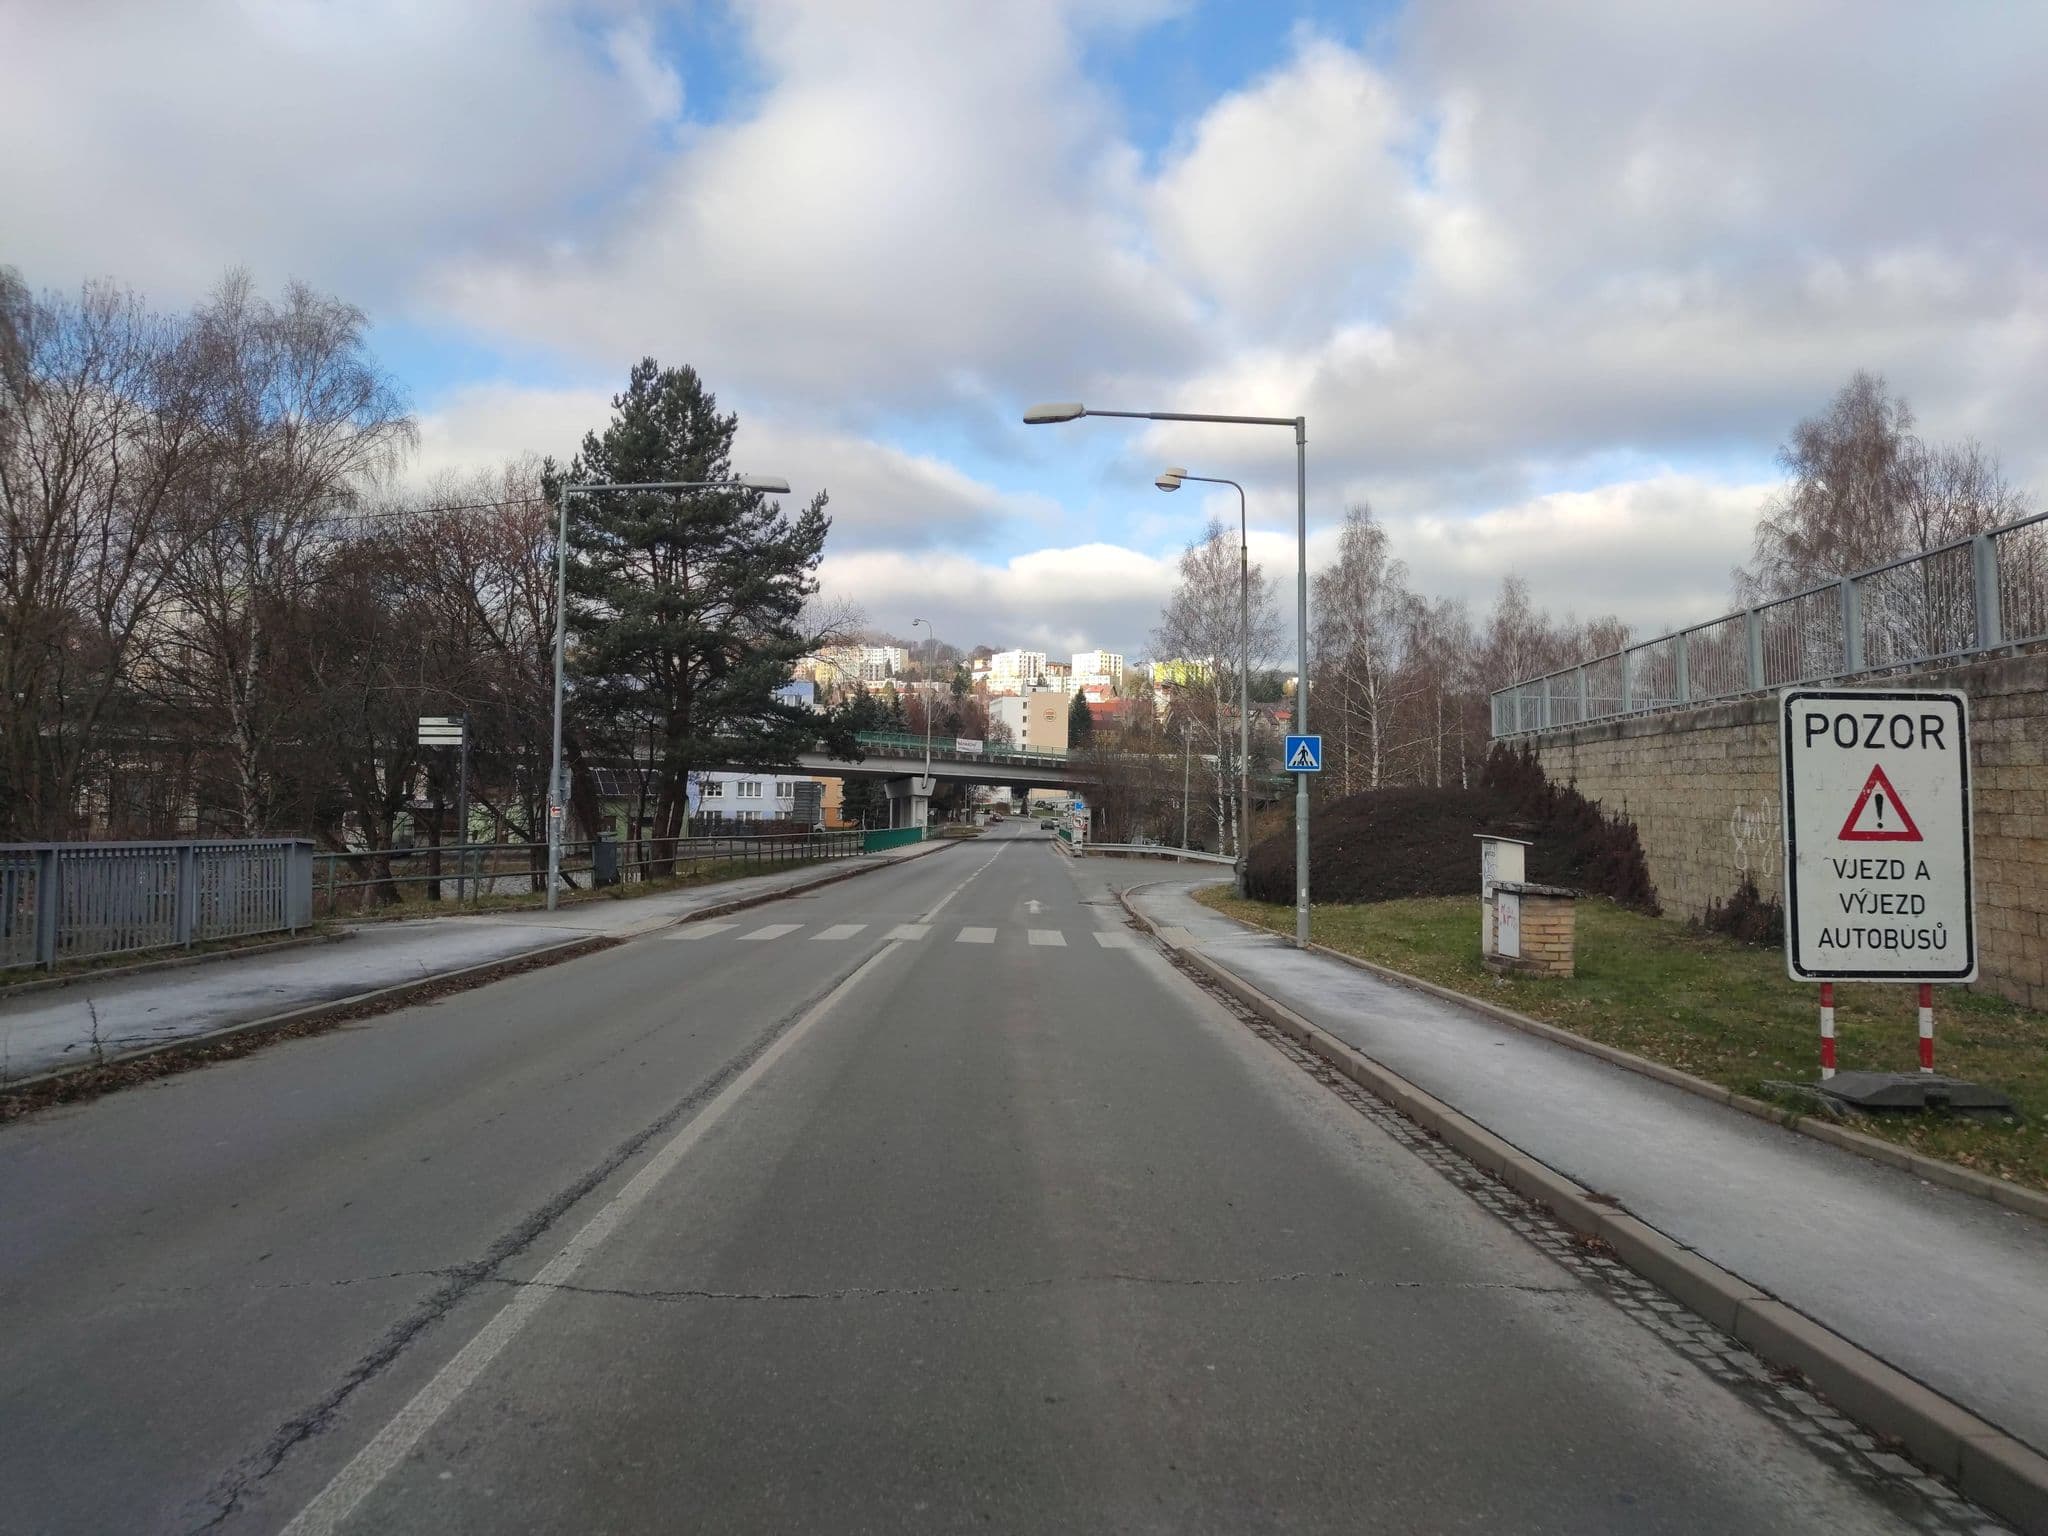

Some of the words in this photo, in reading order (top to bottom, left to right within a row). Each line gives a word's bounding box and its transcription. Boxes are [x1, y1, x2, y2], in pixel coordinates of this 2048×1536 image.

[1805, 712, 1946, 750] POZOR
[1832, 858, 1905, 880] VJEZD
[1914, 859, 1931, 880] A
[1839, 888, 1926, 915] VÝJEZD
[1817, 922, 1947, 950] AUTOBUSŮ
